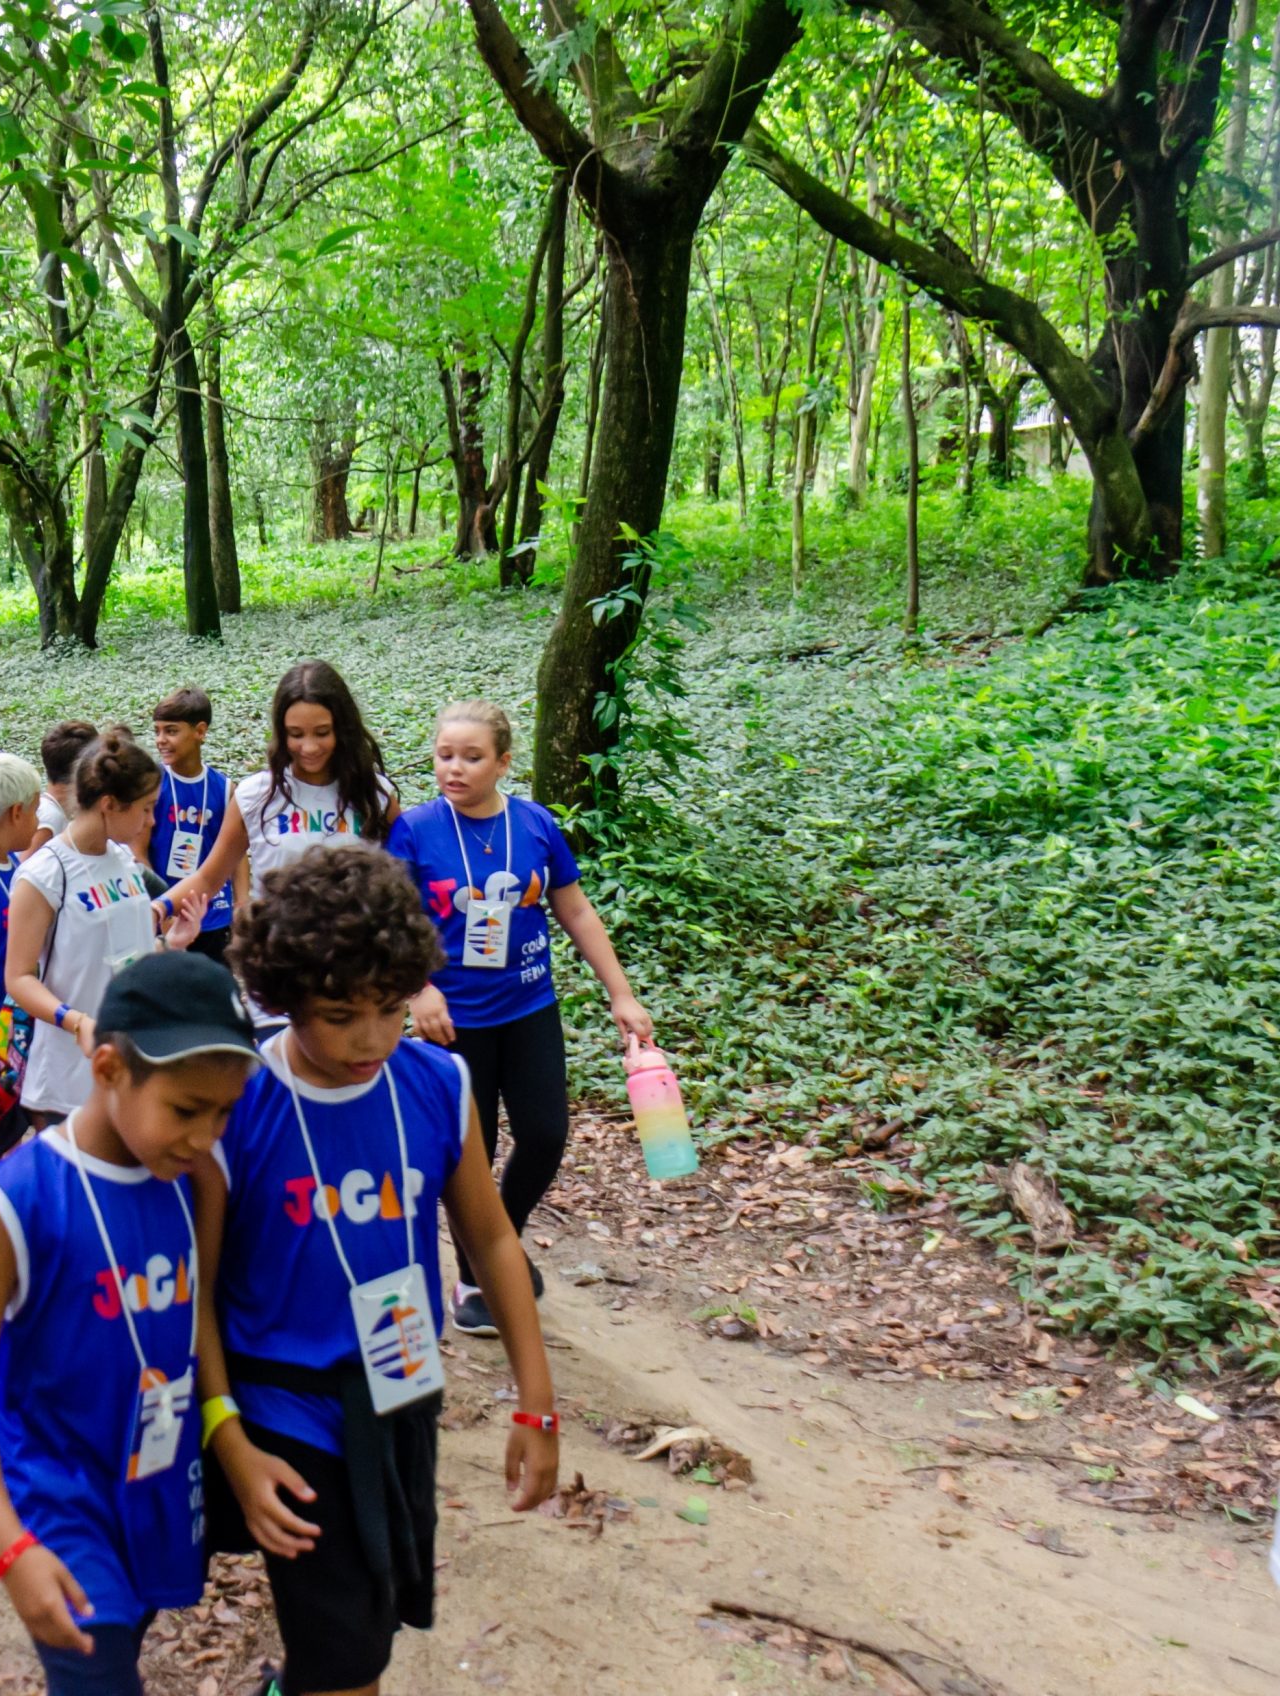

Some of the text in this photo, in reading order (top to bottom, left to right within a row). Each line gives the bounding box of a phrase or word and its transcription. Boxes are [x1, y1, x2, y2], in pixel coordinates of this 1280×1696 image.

[168, 804, 213, 826] JOGAR
[284, 1167, 425, 1227] JOGAR
[92, 1253, 193, 1320] JOGA
